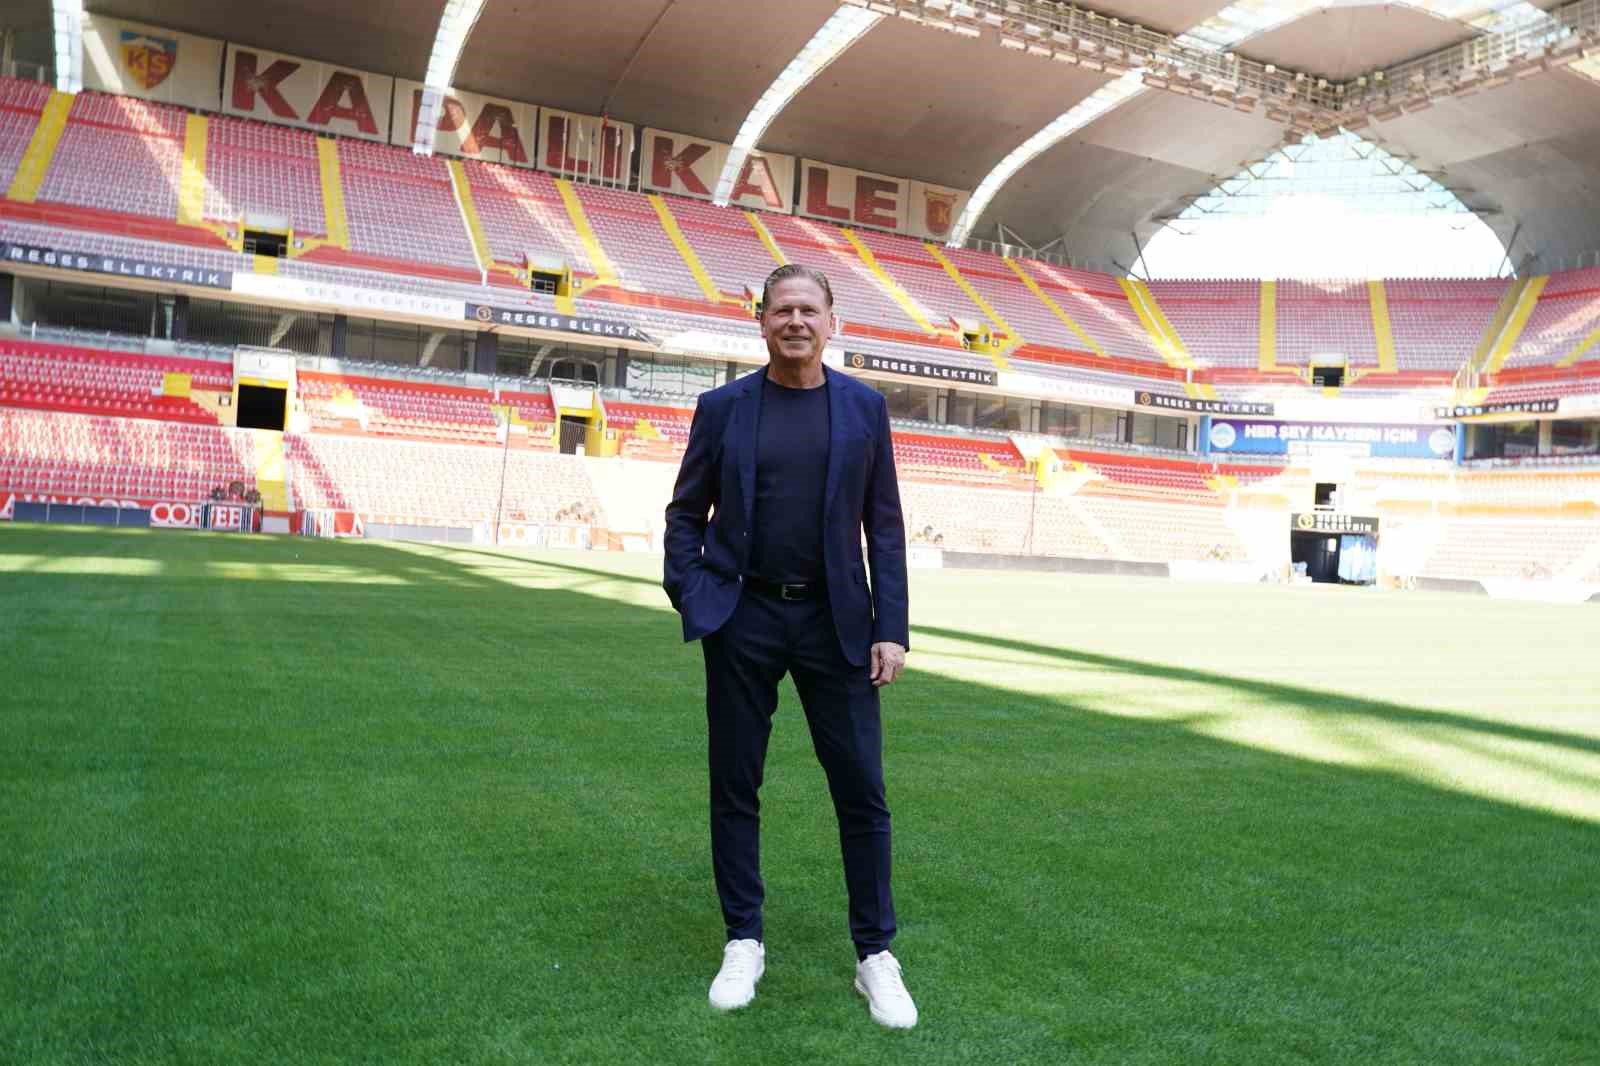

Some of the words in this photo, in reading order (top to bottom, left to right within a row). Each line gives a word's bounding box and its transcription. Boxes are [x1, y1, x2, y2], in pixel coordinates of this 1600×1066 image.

[652, 136, 899, 228] KALE
[502, 311, 559, 328] REGES
[872, 359, 917, 373] REGES
[1244, 424, 1277, 438] HER
